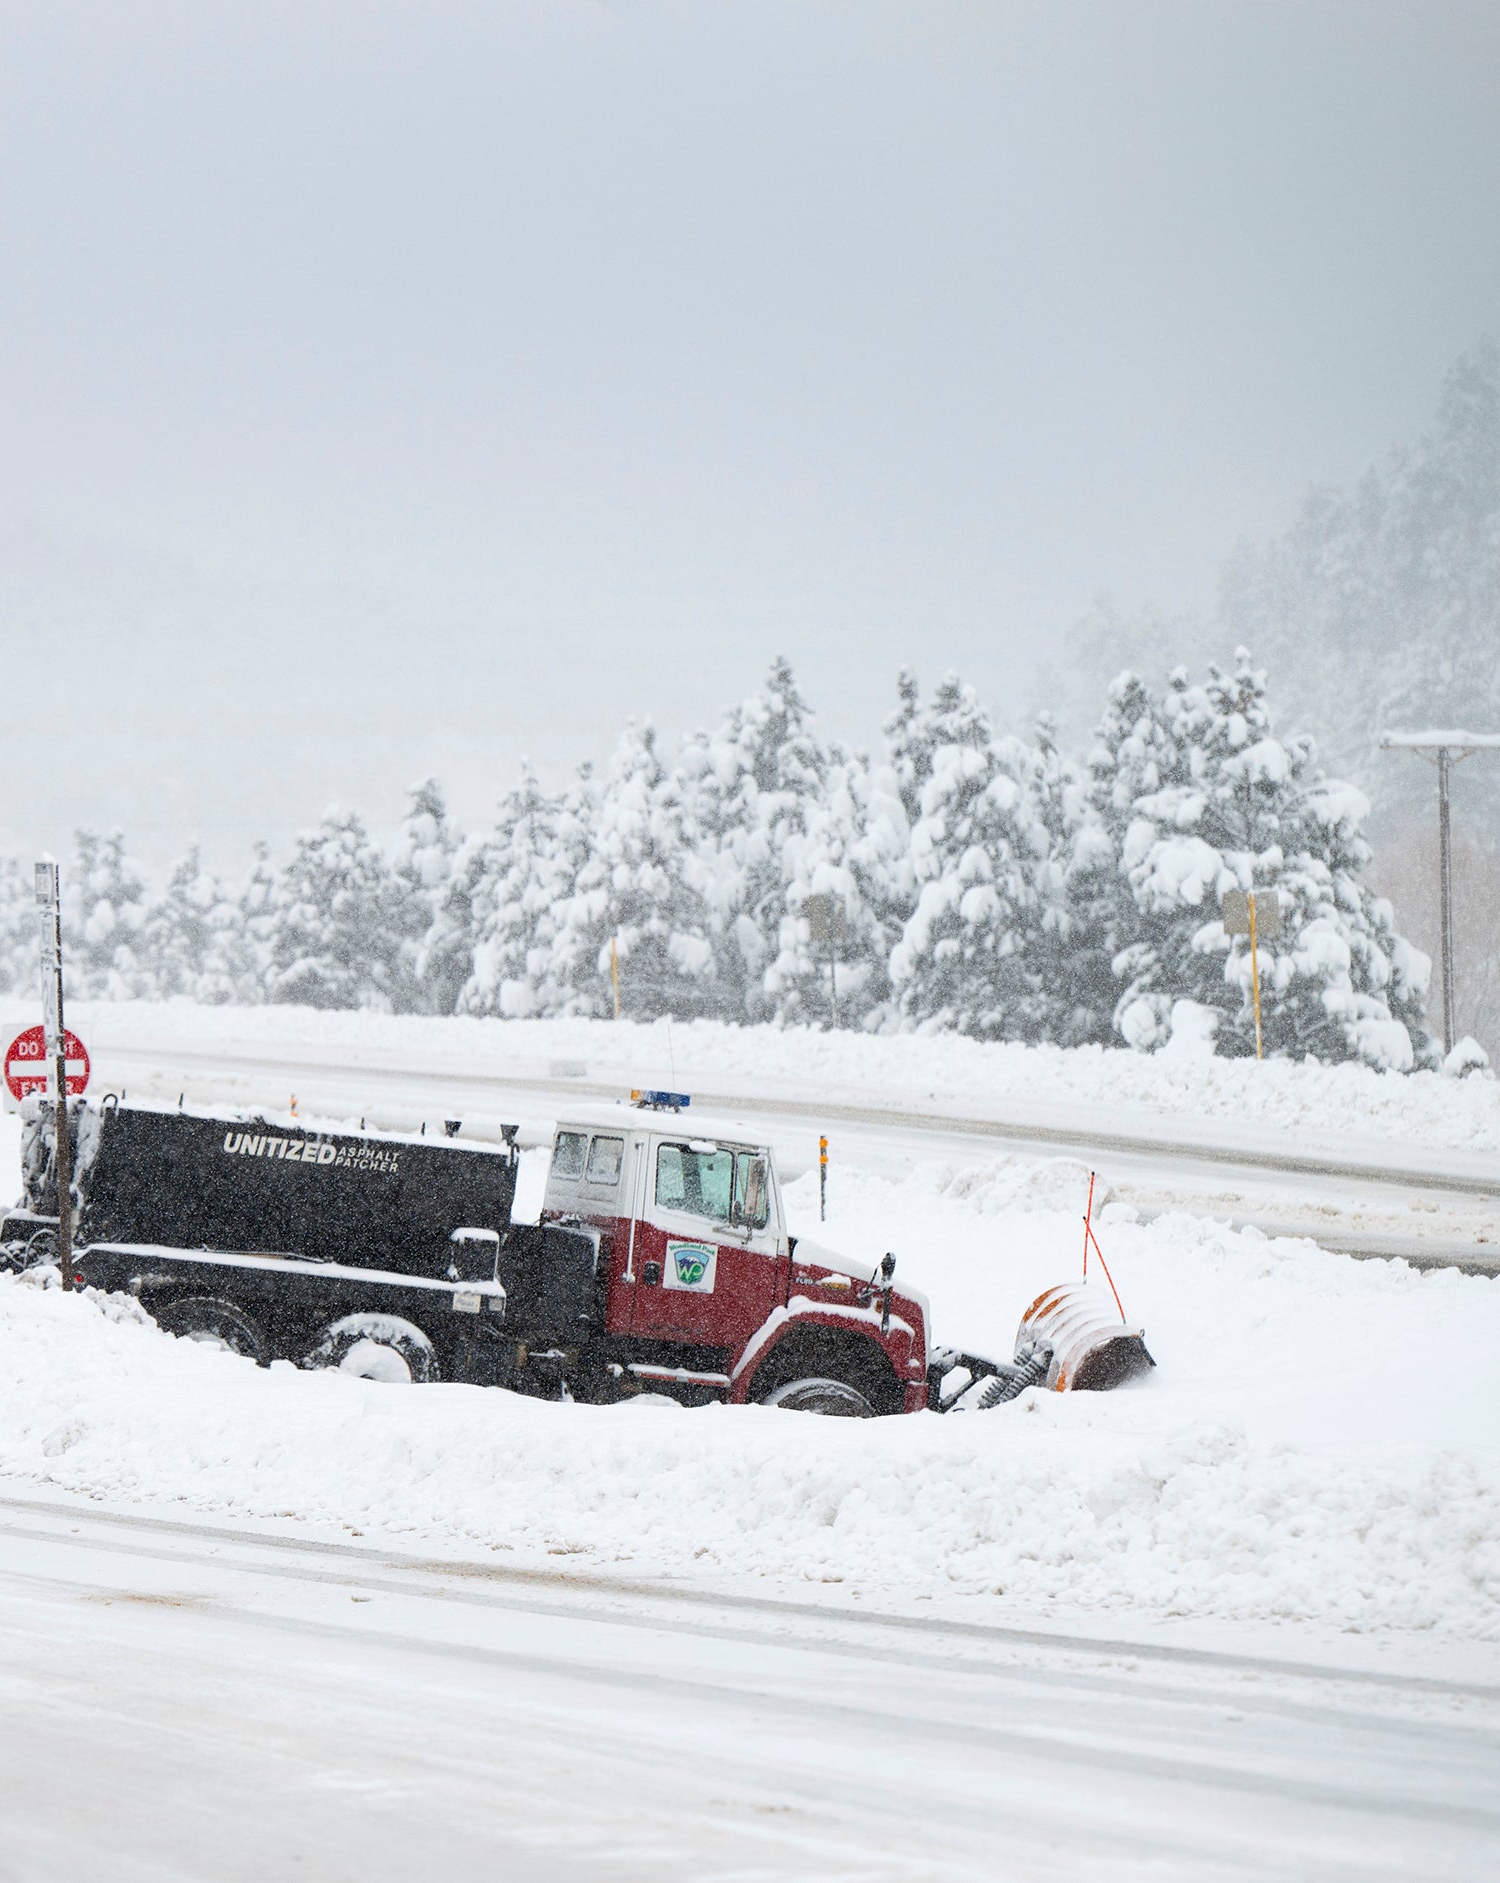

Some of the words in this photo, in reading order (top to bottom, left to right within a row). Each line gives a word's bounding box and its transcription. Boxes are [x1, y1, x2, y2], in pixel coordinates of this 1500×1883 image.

[19, 1041, 39, 1056] DO
[223, 1132, 337, 1165] UNITIZED
[337, 1146, 400, 1162] ASPHALT
[335, 1157, 399, 1173] PATCHER
